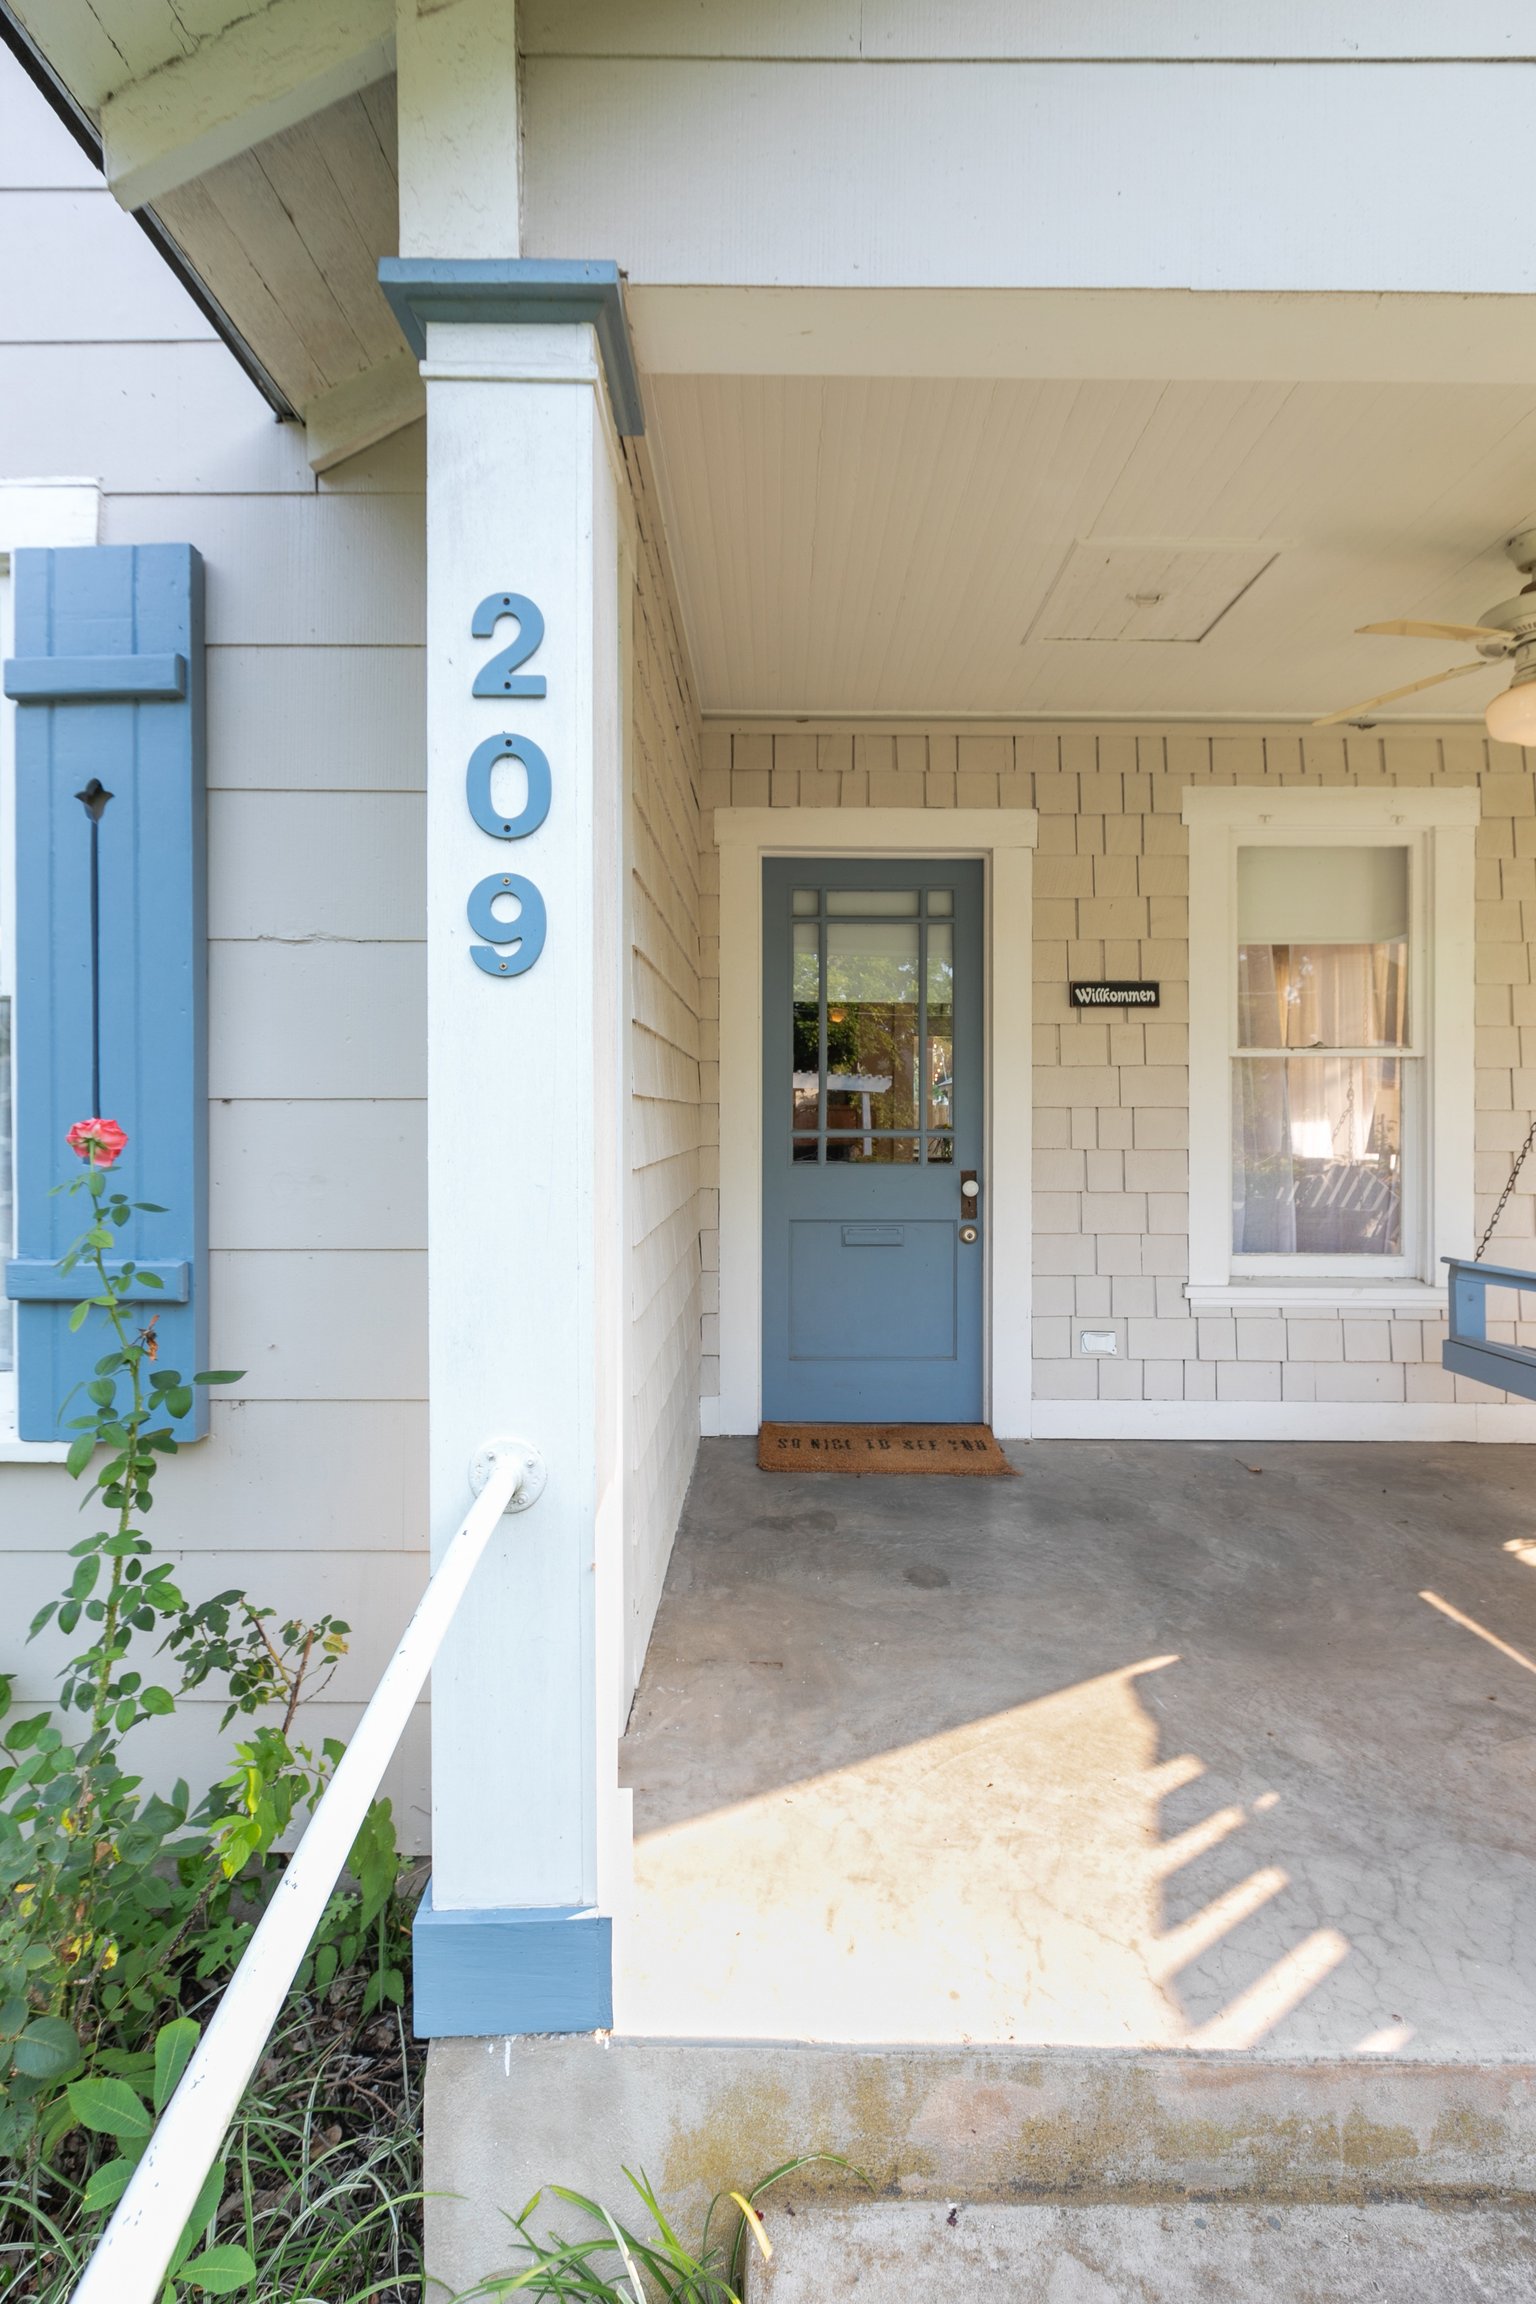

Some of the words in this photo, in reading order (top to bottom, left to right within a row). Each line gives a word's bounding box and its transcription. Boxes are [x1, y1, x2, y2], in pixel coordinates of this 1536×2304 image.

[466, 592, 552, 977] 209
[1075, 987, 1156, 1004] Willkommen
[778, 1438, 800, 1449] SO
